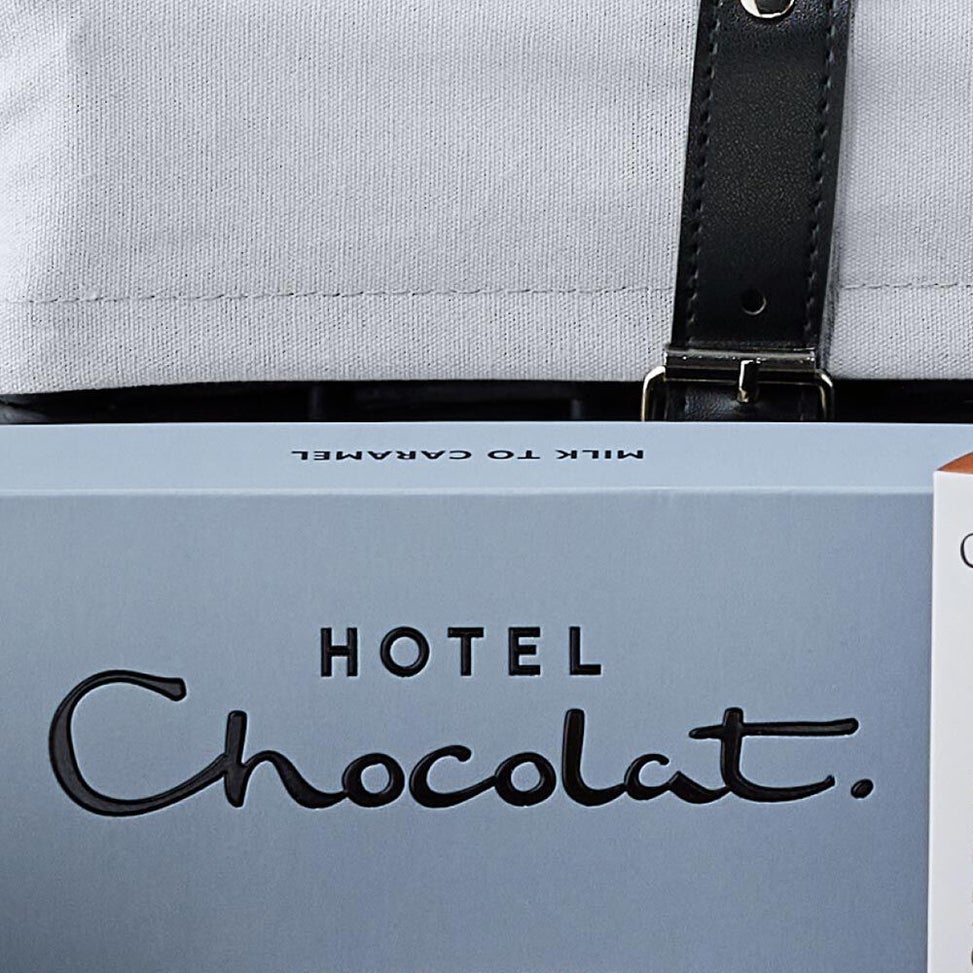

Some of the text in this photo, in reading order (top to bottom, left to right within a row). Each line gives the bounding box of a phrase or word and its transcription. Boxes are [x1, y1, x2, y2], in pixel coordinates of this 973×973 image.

[291, 450, 644, 460] MILK TO CARAMEL
[319, 626, 602, 677] HOTEL
[48, 668, 874, 817] Chocolat.
